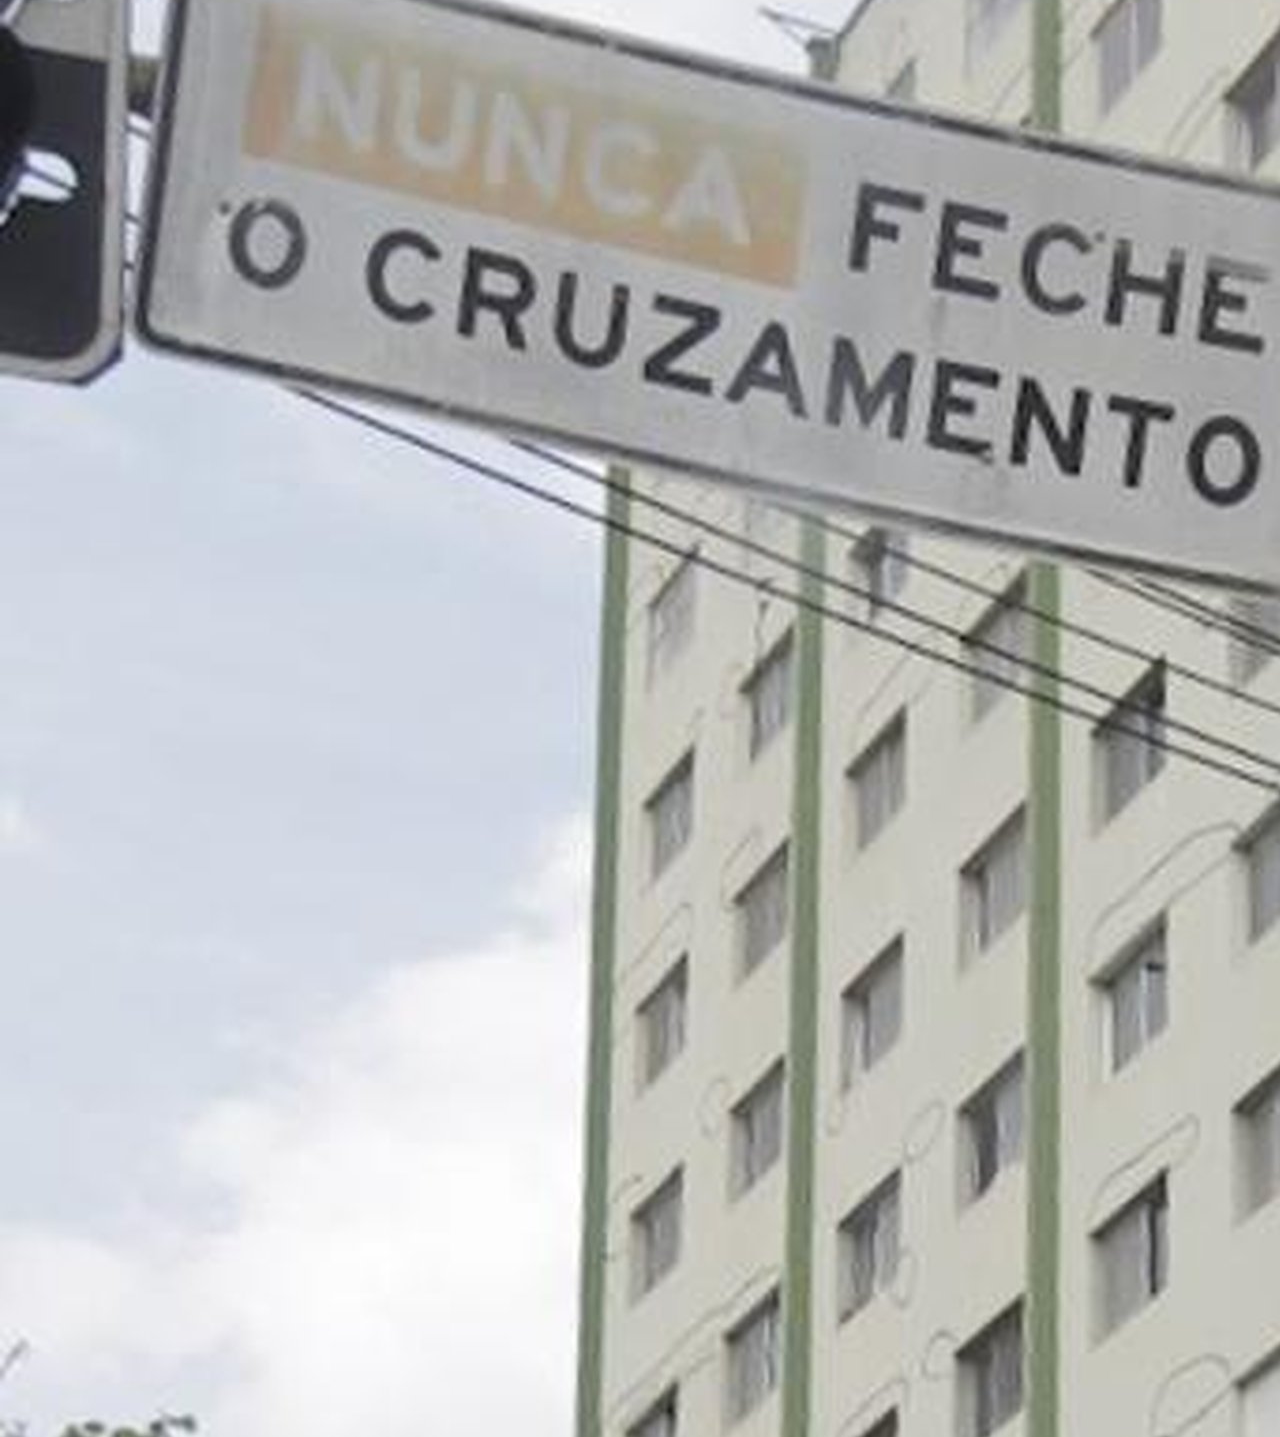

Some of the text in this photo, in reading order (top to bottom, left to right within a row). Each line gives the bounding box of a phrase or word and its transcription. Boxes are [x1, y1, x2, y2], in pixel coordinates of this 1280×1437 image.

[227, 198, 1263, 507] O CRUZAMENTO
[290, 37, 1267, 355] NUNCA FECHE
